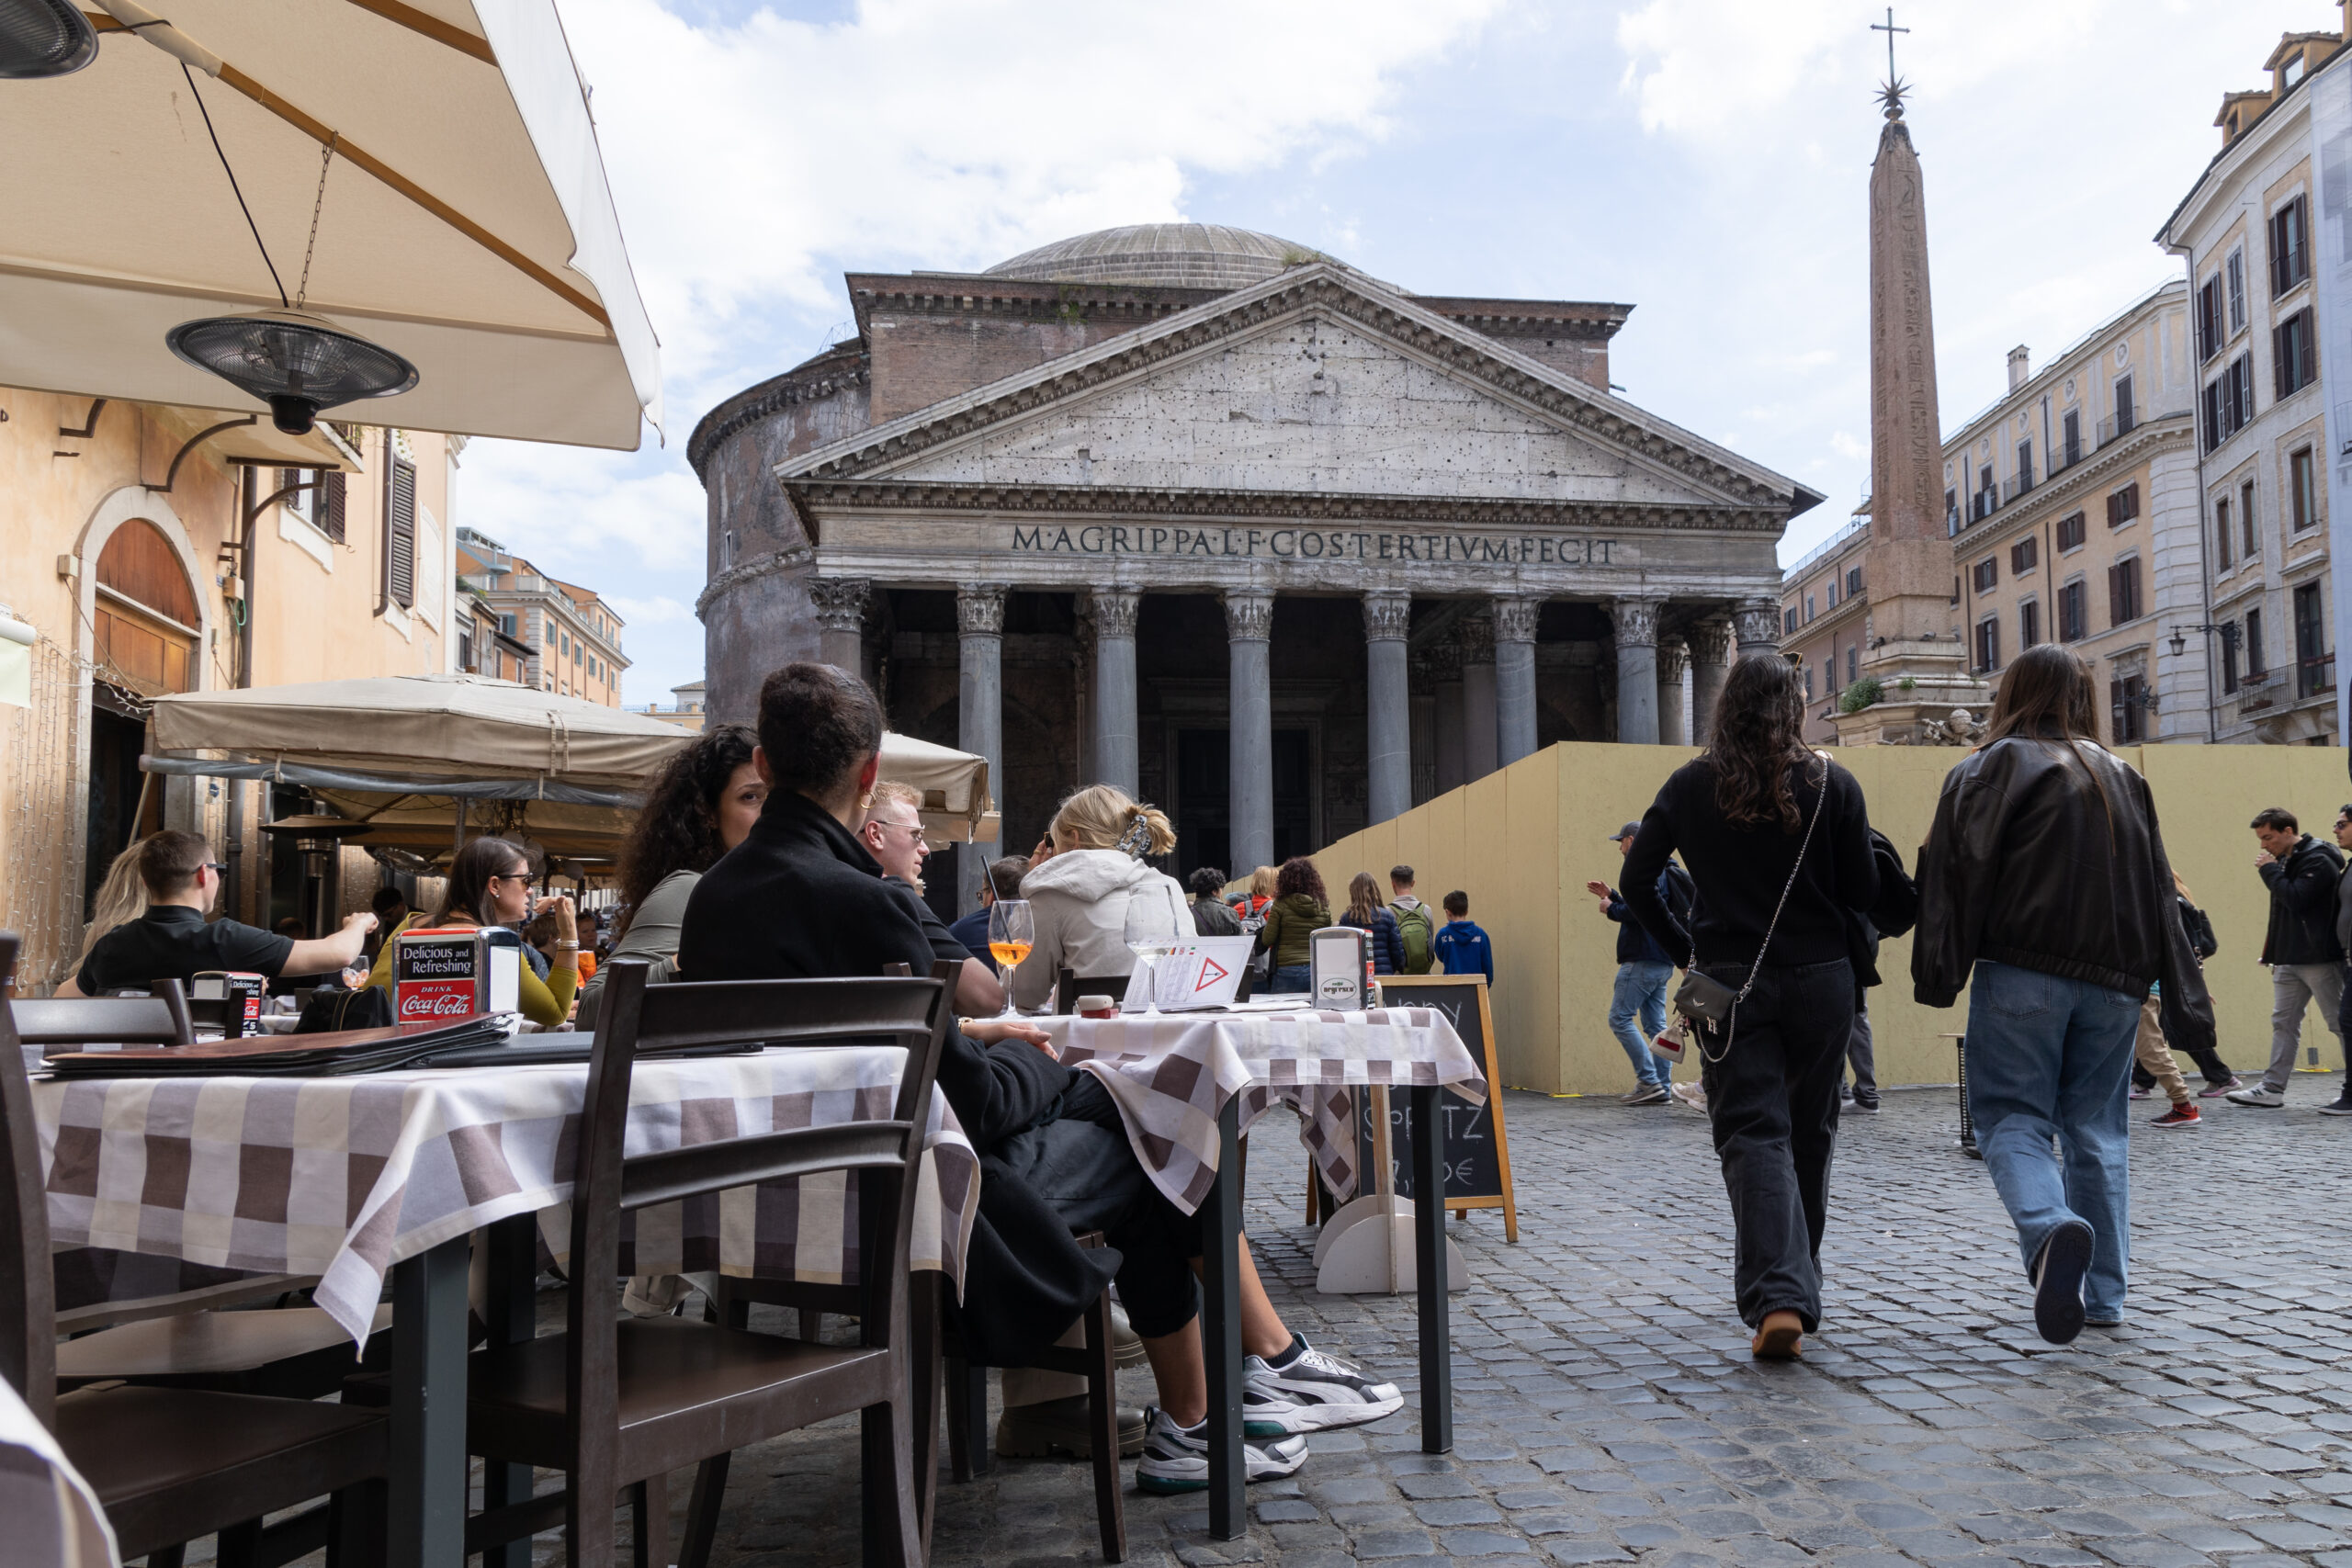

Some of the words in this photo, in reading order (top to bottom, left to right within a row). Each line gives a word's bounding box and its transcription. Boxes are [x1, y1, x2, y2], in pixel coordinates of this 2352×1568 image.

[1012, 525, 1046, 551] M
[1050, 526, 1216, 555] AGRIPPA
[1271, 530, 1343, 557] COS
[1351, 533, 1510, 561] TERTIVM
[1520, 537, 1618, 564] FECIT
[404, 945, 453, 960] Delicious
[456, 949, 469, 957] and
[413, 959, 471, 974] Refreshing
[401, 994, 471, 1015] Coca-Cola
